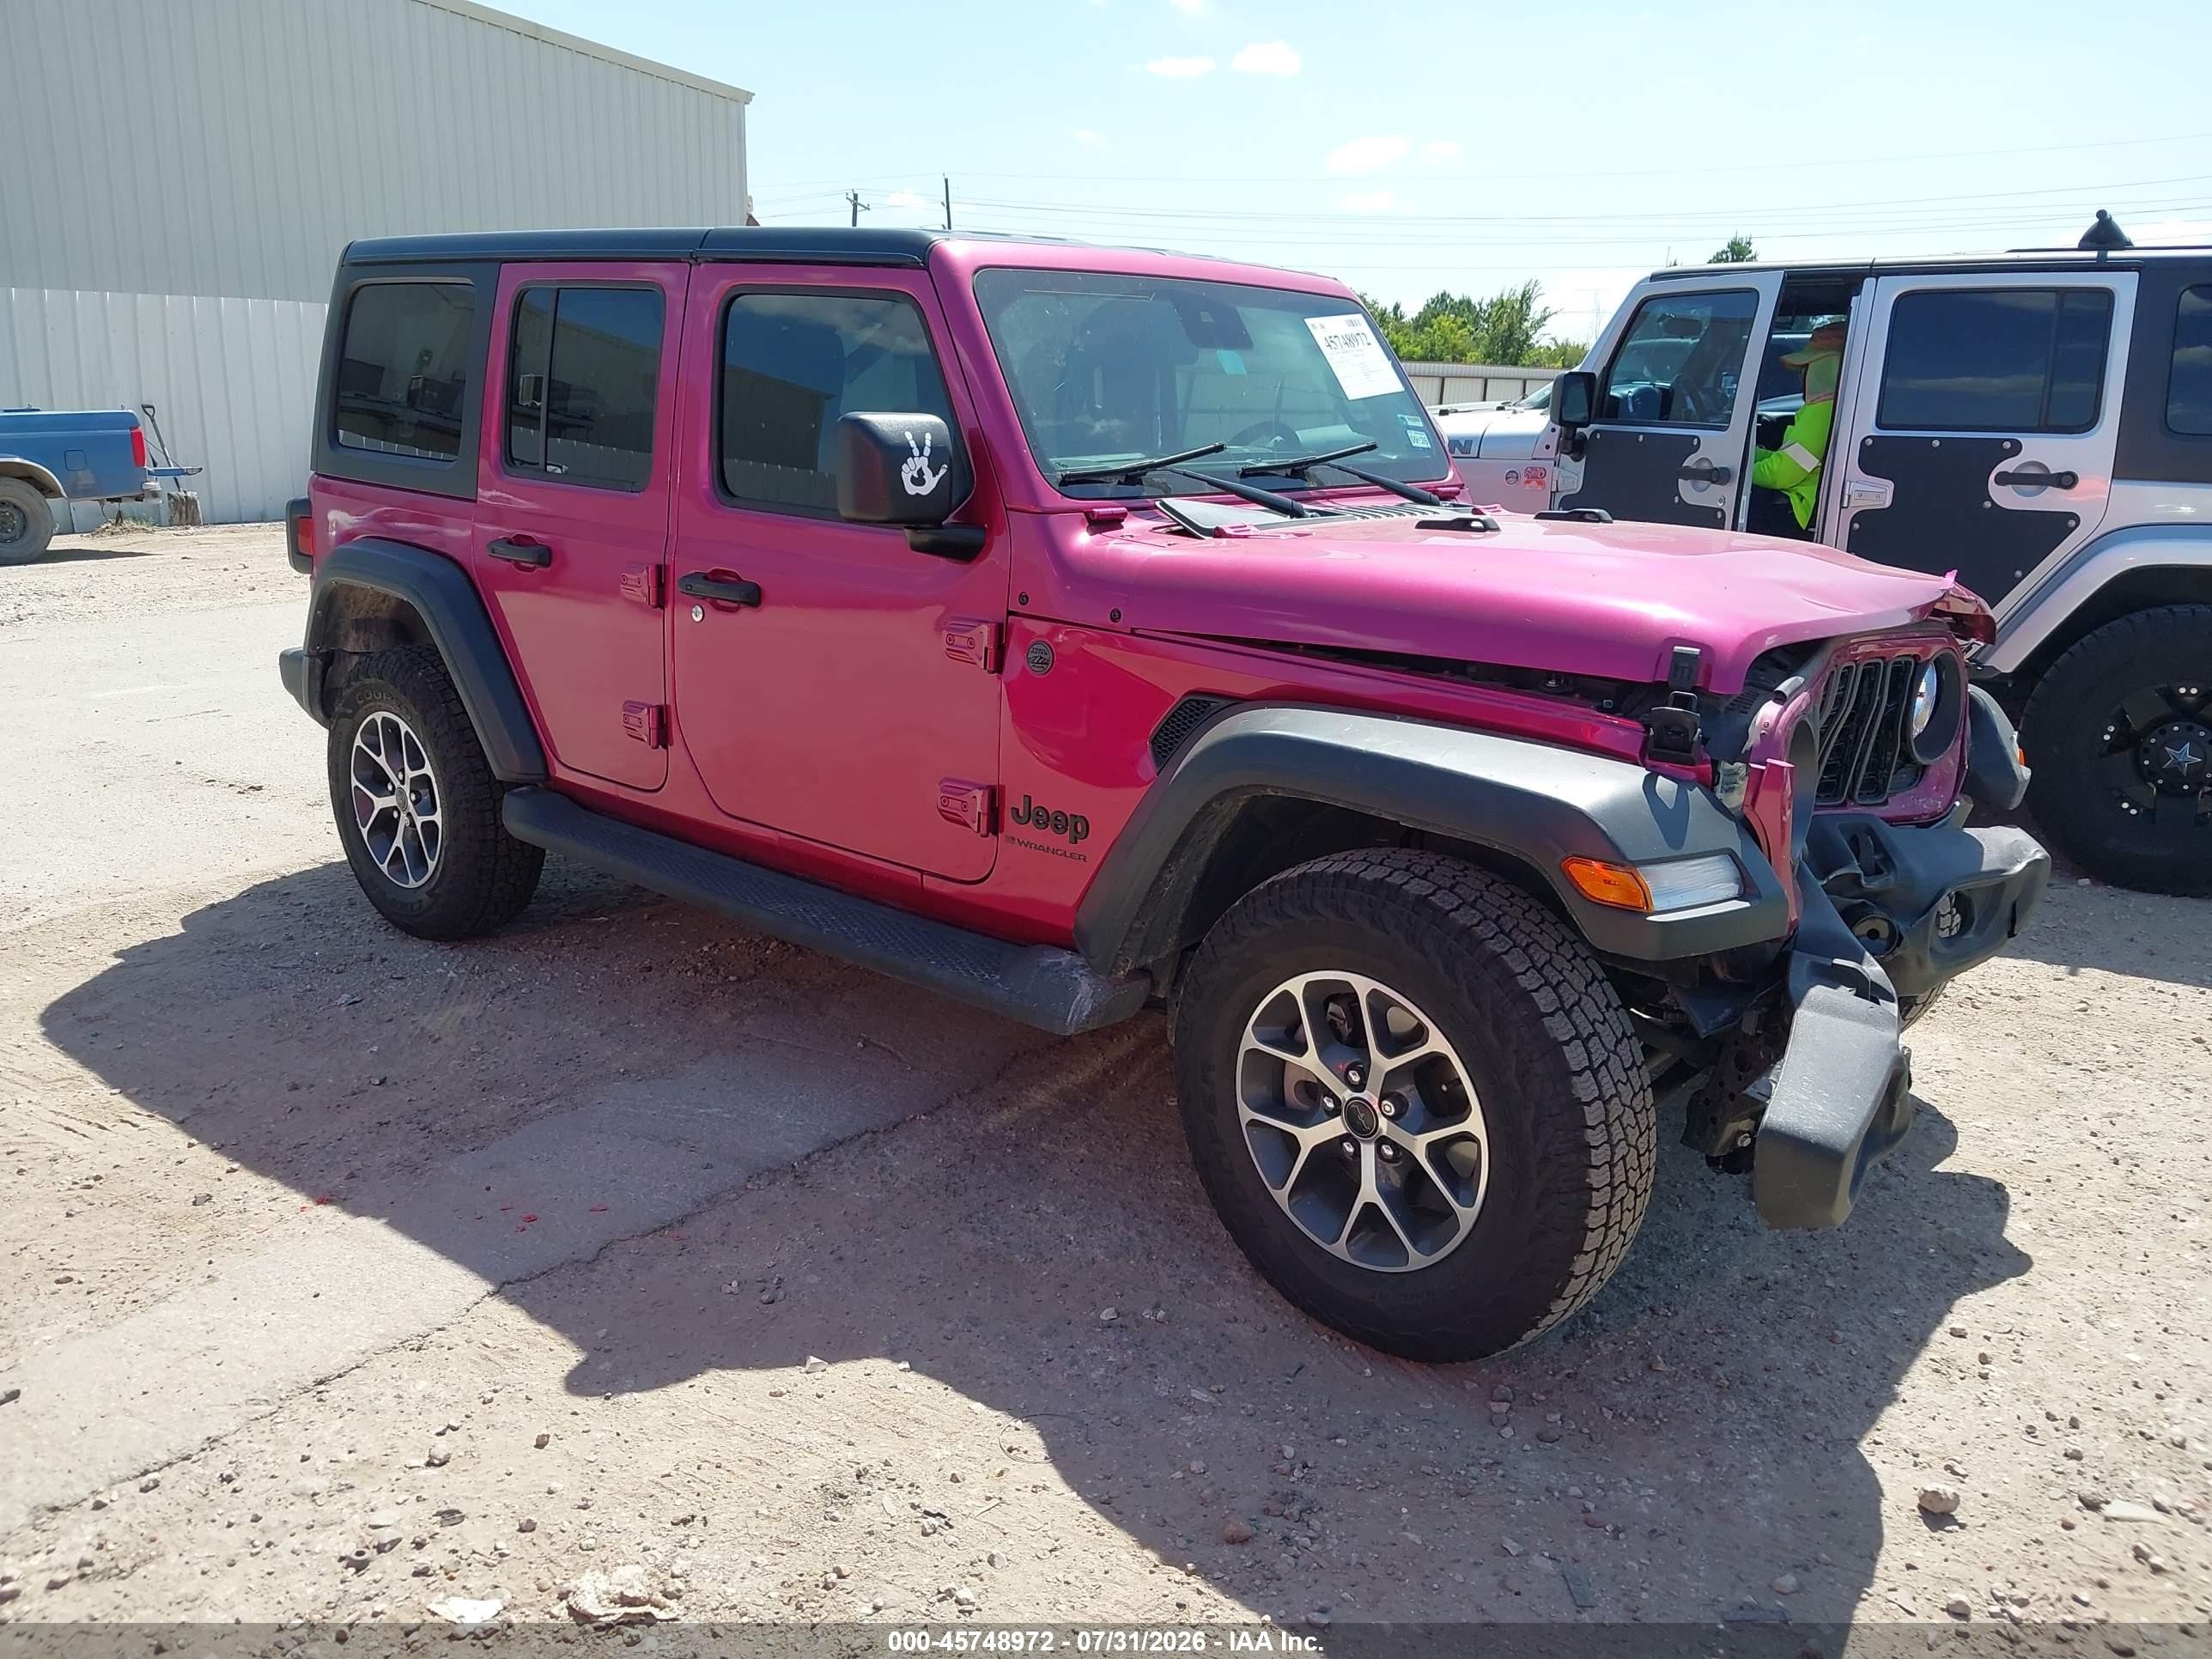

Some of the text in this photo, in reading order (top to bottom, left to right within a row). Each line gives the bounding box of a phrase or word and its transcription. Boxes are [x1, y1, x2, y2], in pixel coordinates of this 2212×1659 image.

[1325, 332, 1371, 349] 45748972
[1011, 794, 1090, 844] Jeep
[1017, 838, 1087, 863] WRANGLER
